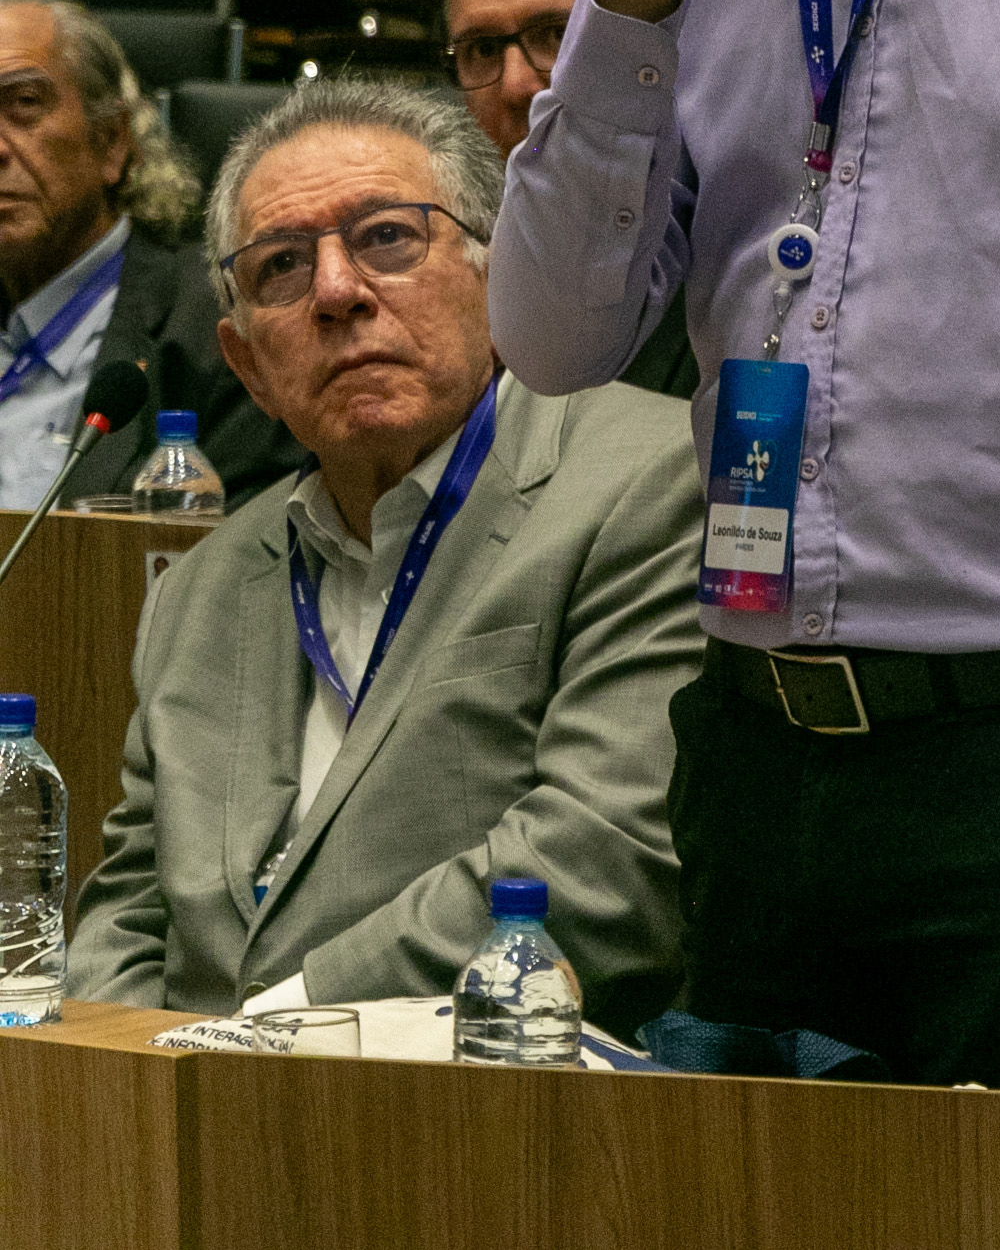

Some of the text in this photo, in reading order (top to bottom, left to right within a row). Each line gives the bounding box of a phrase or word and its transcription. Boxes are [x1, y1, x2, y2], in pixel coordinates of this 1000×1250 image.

[730, 467, 753, 480] RIPSA
[712, 524, 782, 541] Leonildo de Souza
